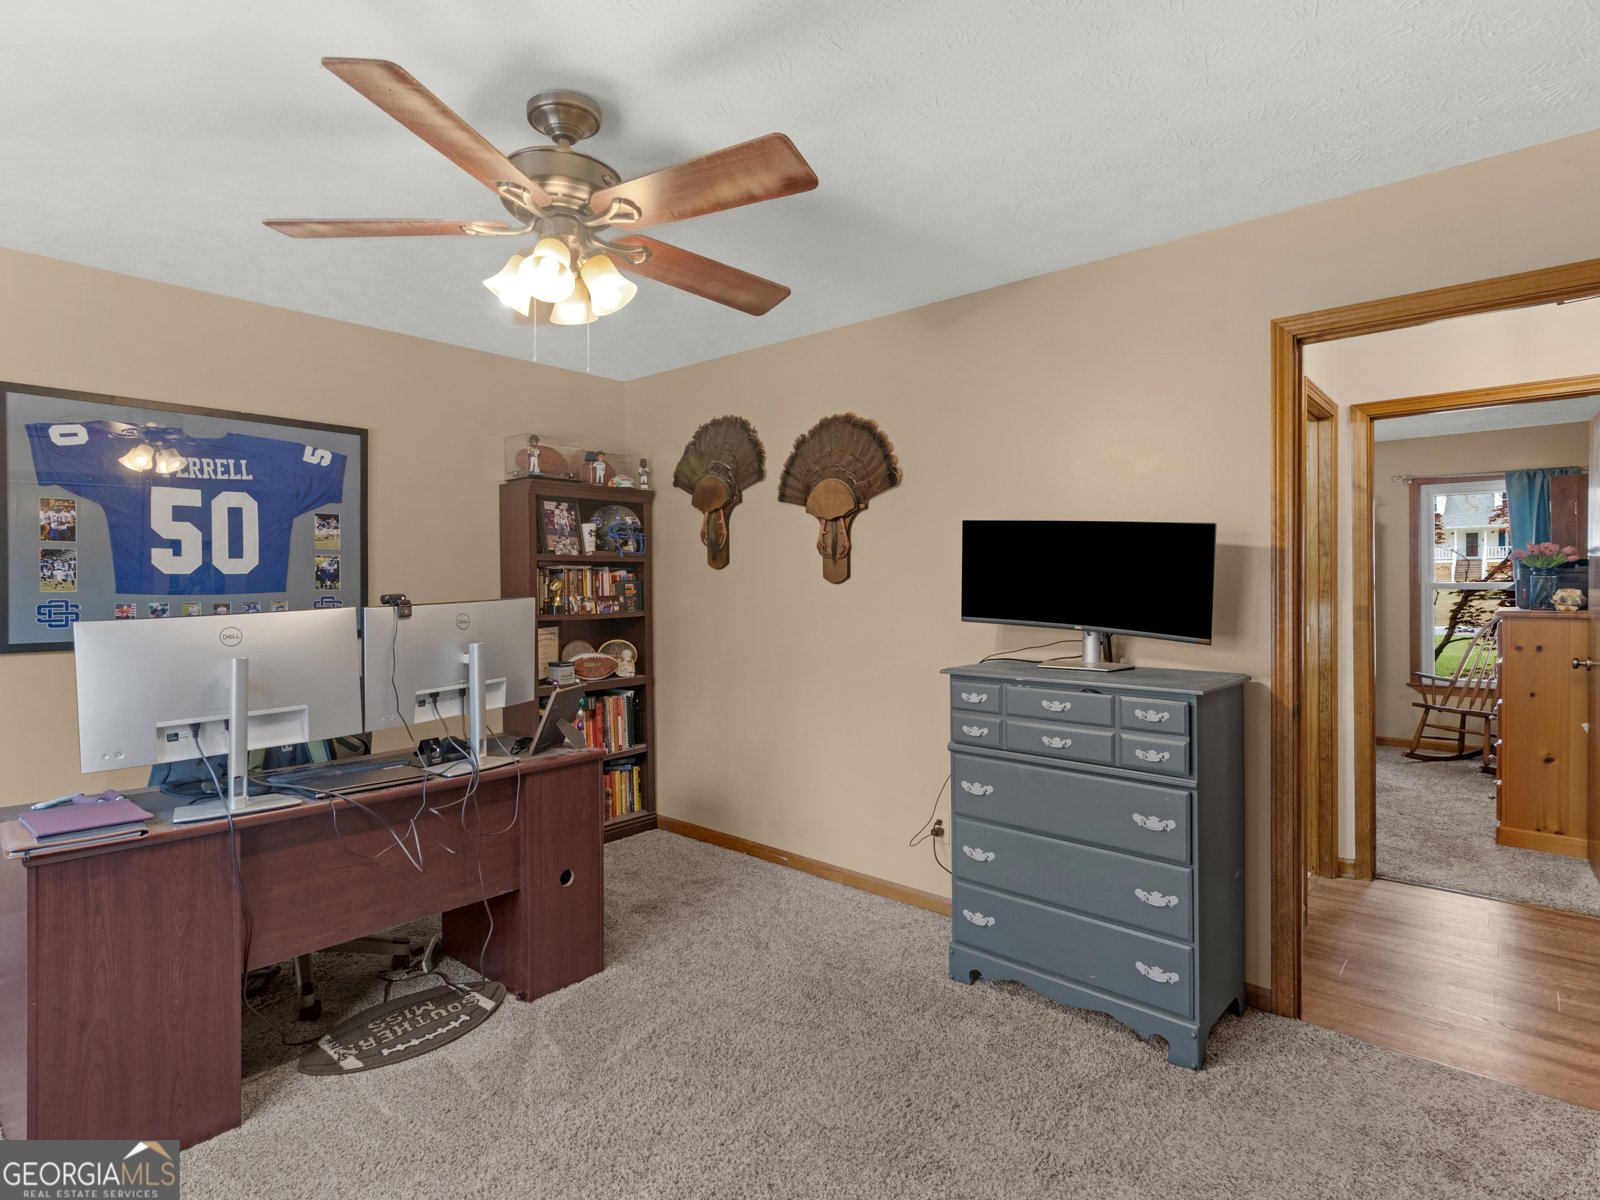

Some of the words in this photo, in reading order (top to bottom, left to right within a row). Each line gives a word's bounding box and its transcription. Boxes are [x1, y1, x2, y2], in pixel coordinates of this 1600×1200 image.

[163, 457, 253, 480] ERRELL
[151, 486, 259, 575] 50
[334, 992, 480, 1062] SOUTHERN
[368, 1000, 436, 1033] MISS
